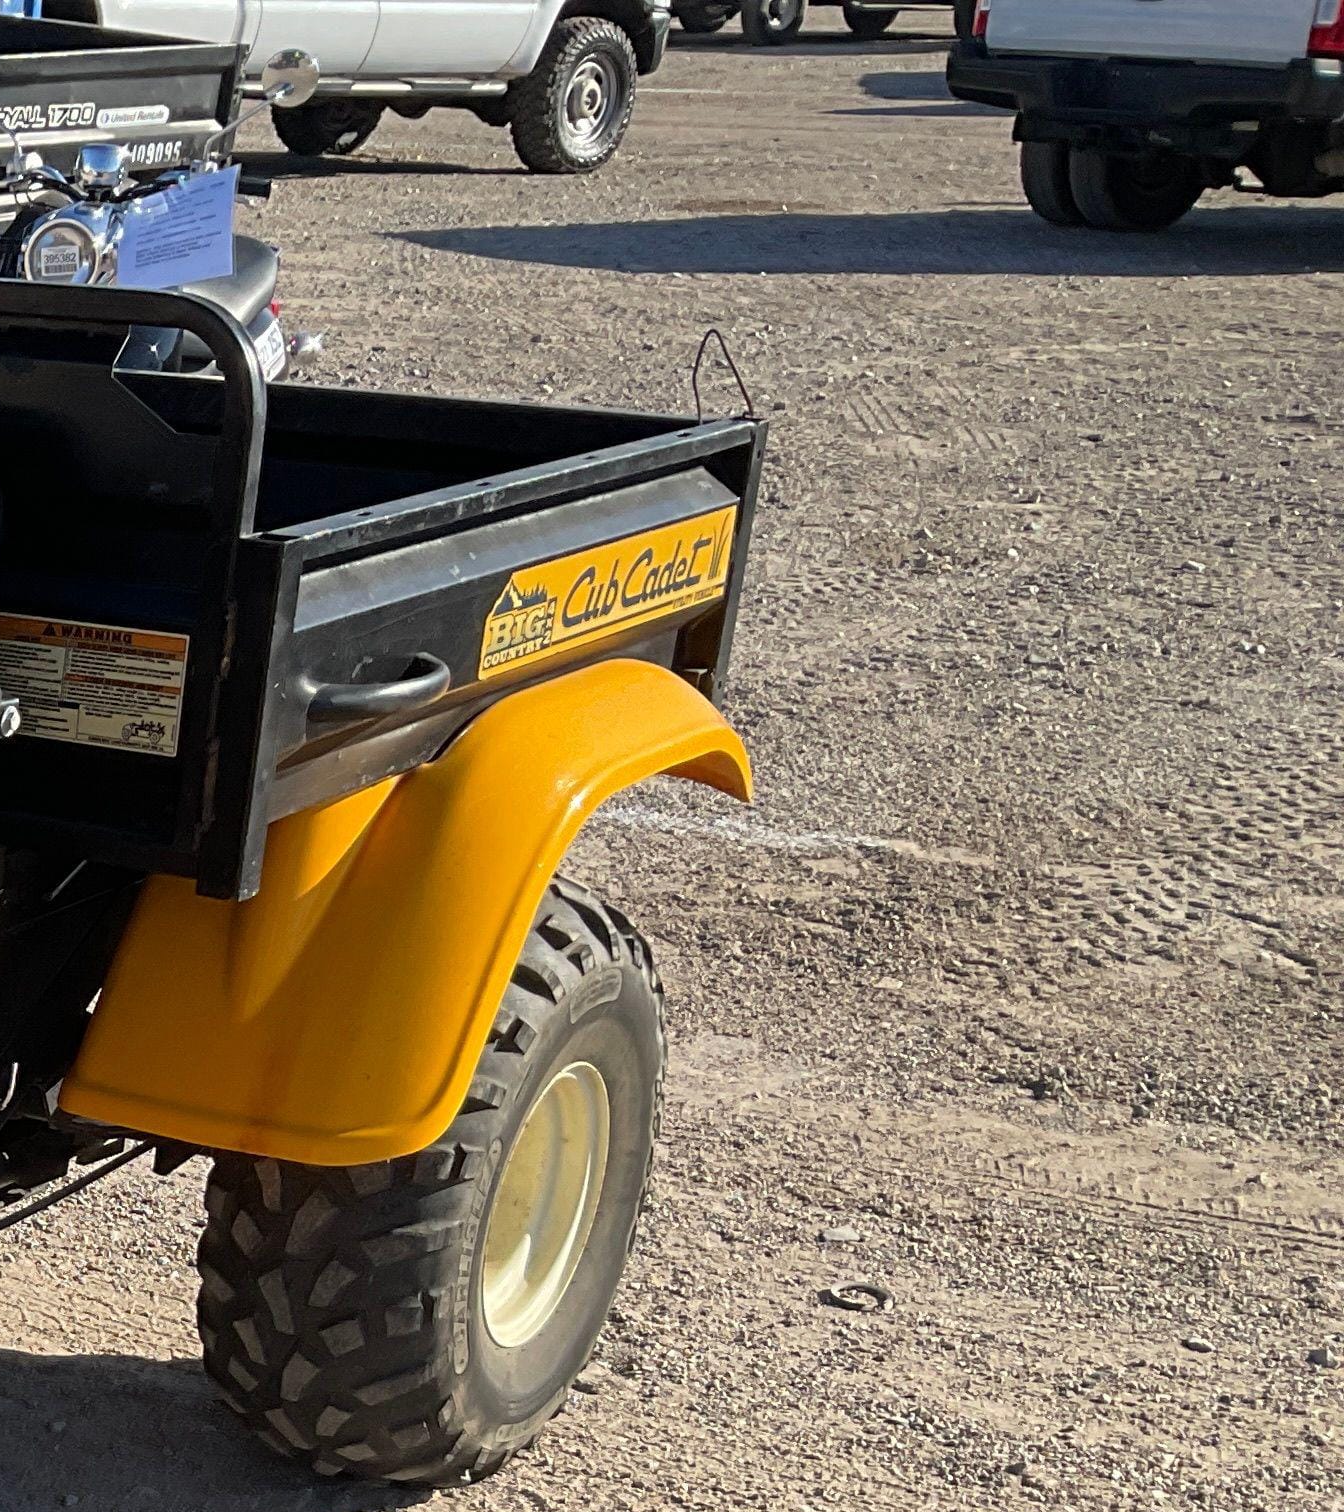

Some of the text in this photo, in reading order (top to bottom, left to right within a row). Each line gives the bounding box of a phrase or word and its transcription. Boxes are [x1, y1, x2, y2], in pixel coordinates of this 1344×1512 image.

[47, 102, 96, 127] 1700
[561, 533, 713, 629] Cub Cadet
[61, 624, 132, 645] WARNING
[485, 604, 546, 654] BIG
[483, 636, 544, 669] COUNTRY
